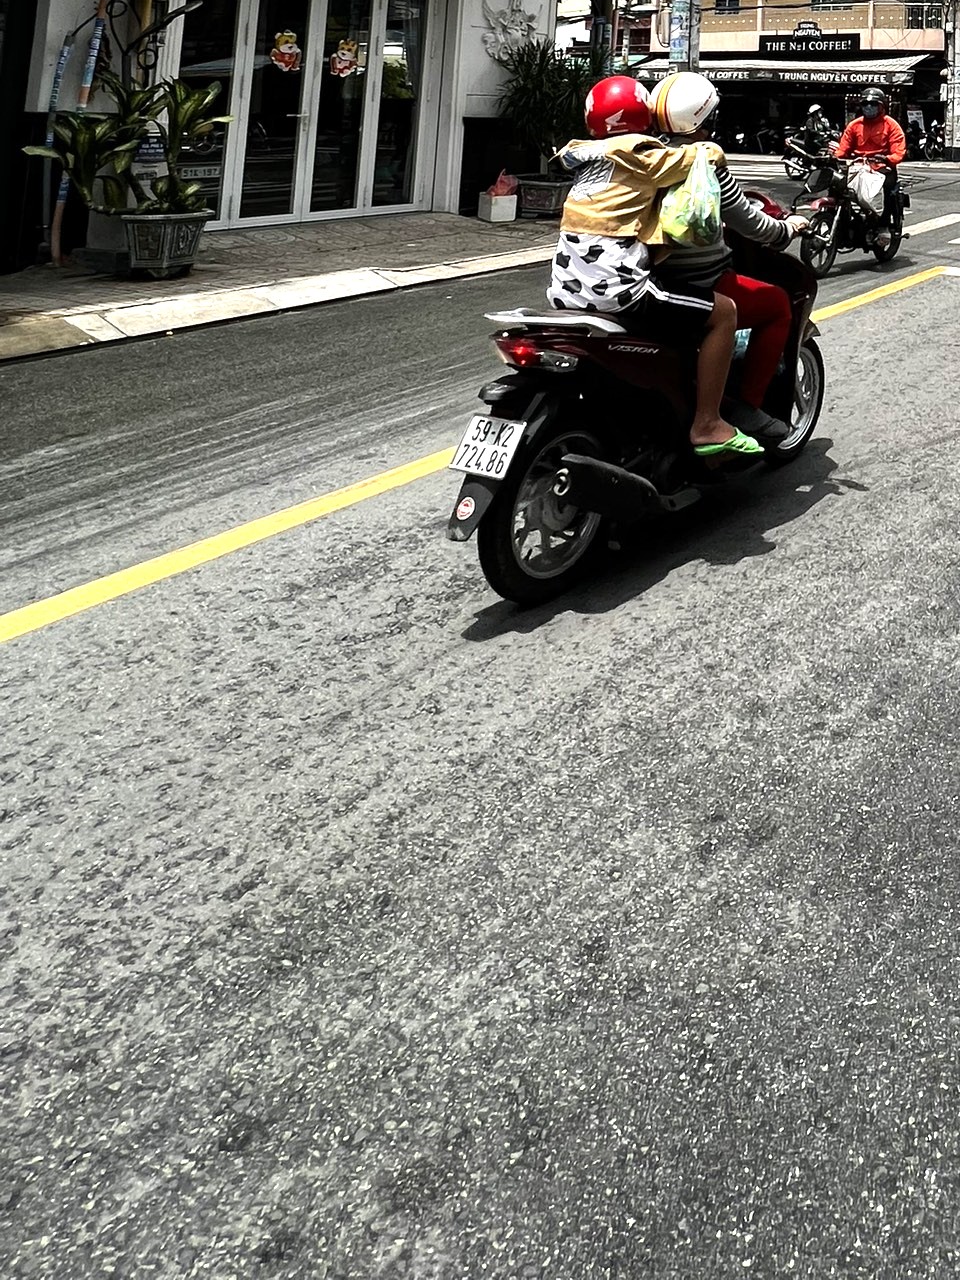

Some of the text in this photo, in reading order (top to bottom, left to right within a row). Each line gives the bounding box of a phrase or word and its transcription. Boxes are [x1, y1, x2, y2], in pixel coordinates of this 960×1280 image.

[766, 41, 786, 51] THE
[808, 40, 851, 51] COFFEE!
[715, 71, 750, 80] COFFEE
[778, 72, 808, 81] TRUNG
[850, 73, 887, 83] COFFEE
[608, 344, 660, 354] VISION
[472, 419, 515, 448] 59-K2
[456, 443, 508, 475] 724.86
